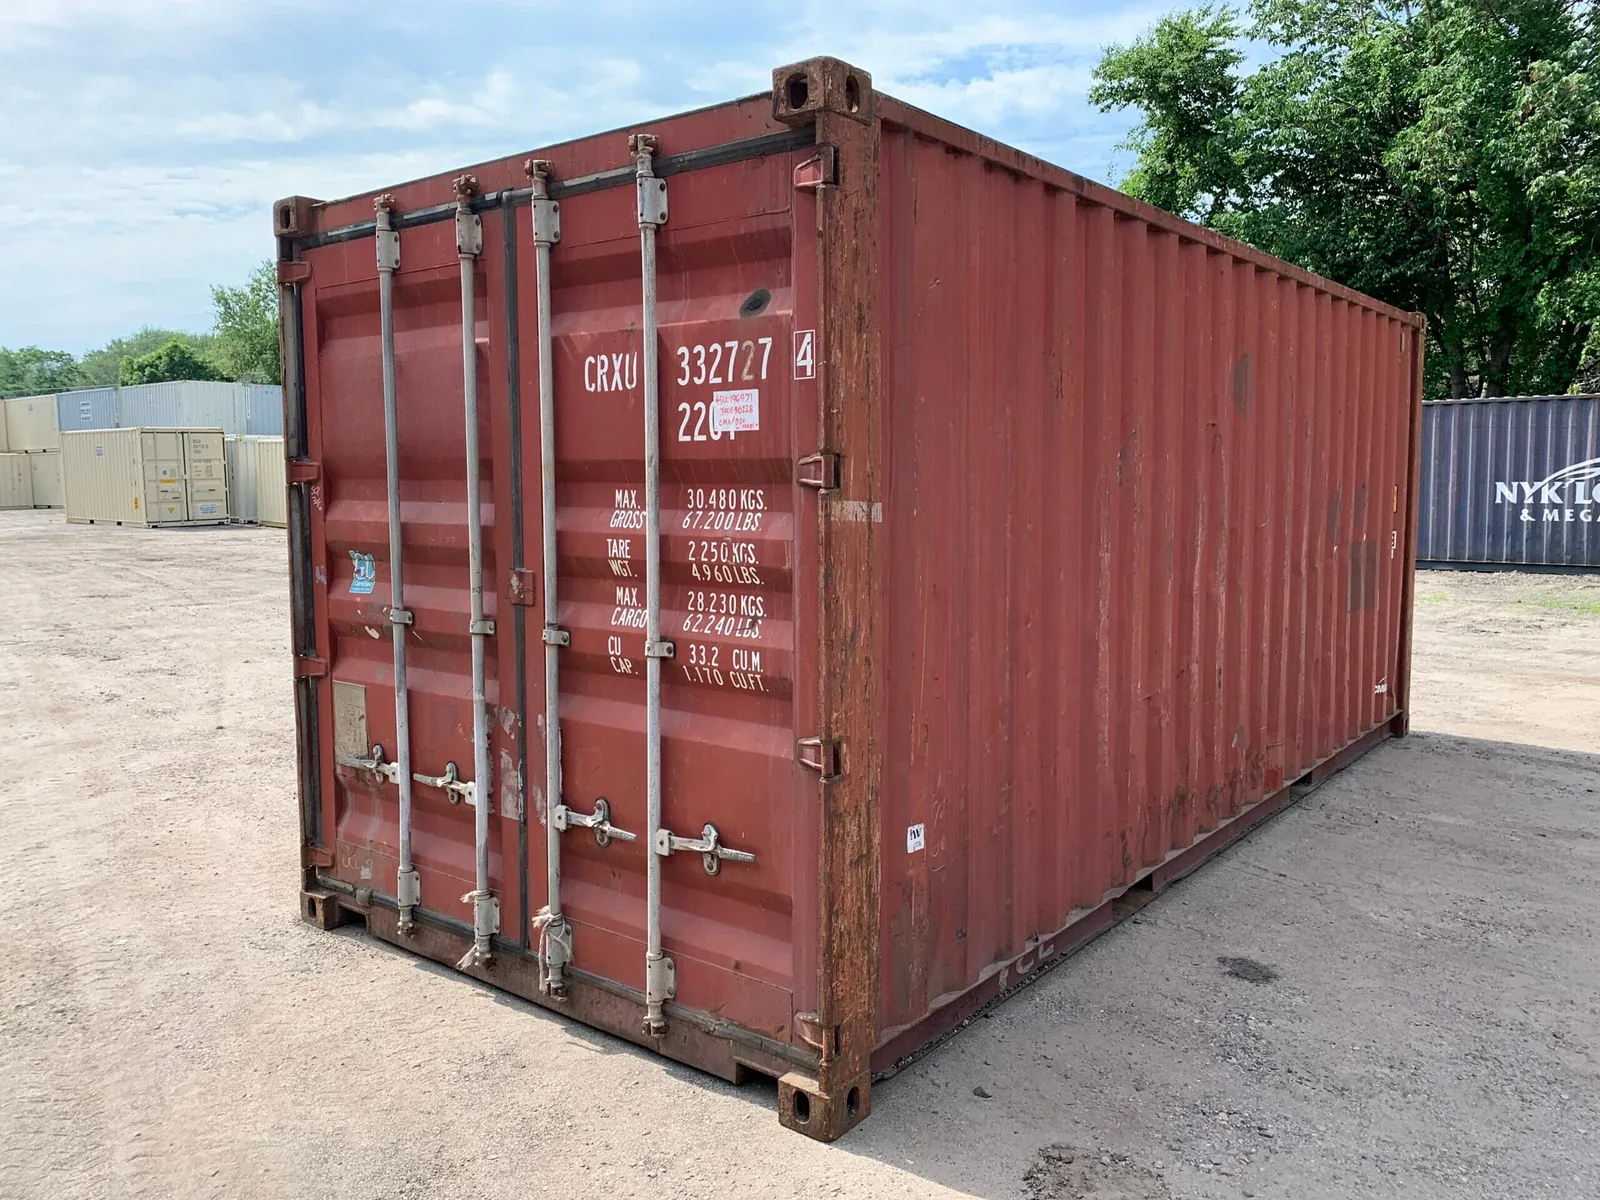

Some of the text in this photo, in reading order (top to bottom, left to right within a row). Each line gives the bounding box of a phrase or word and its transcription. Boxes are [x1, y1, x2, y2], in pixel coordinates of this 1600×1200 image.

[584, 332, 814, 393] CRXU 332727 4
[615, 489, 641, 509] MAX.
[740, 489, 767, 511] KGS.
[1495, 481, 1563, 504] NYK
[610, 510, 647, 529] GROSS
[735, 512, 762, 532] LBS.
[1520, 509, 1600, 522] & MEG
[607, 538, 631, 559] TARE
[732, 542, 759, 565] KGS.
[608, 560, 638, 578] WGT.
[733, 566, 765, 585] LBS.
[616, 587, 642, 607] MAX.
[740, 595, 767, 618] KGS.
[611, 608, 648, 628] CARGO
[608, 636, 621, 656] CU
[689, 644, 719, 667] 33.2
[610, 656, 639, 675] CAP.
